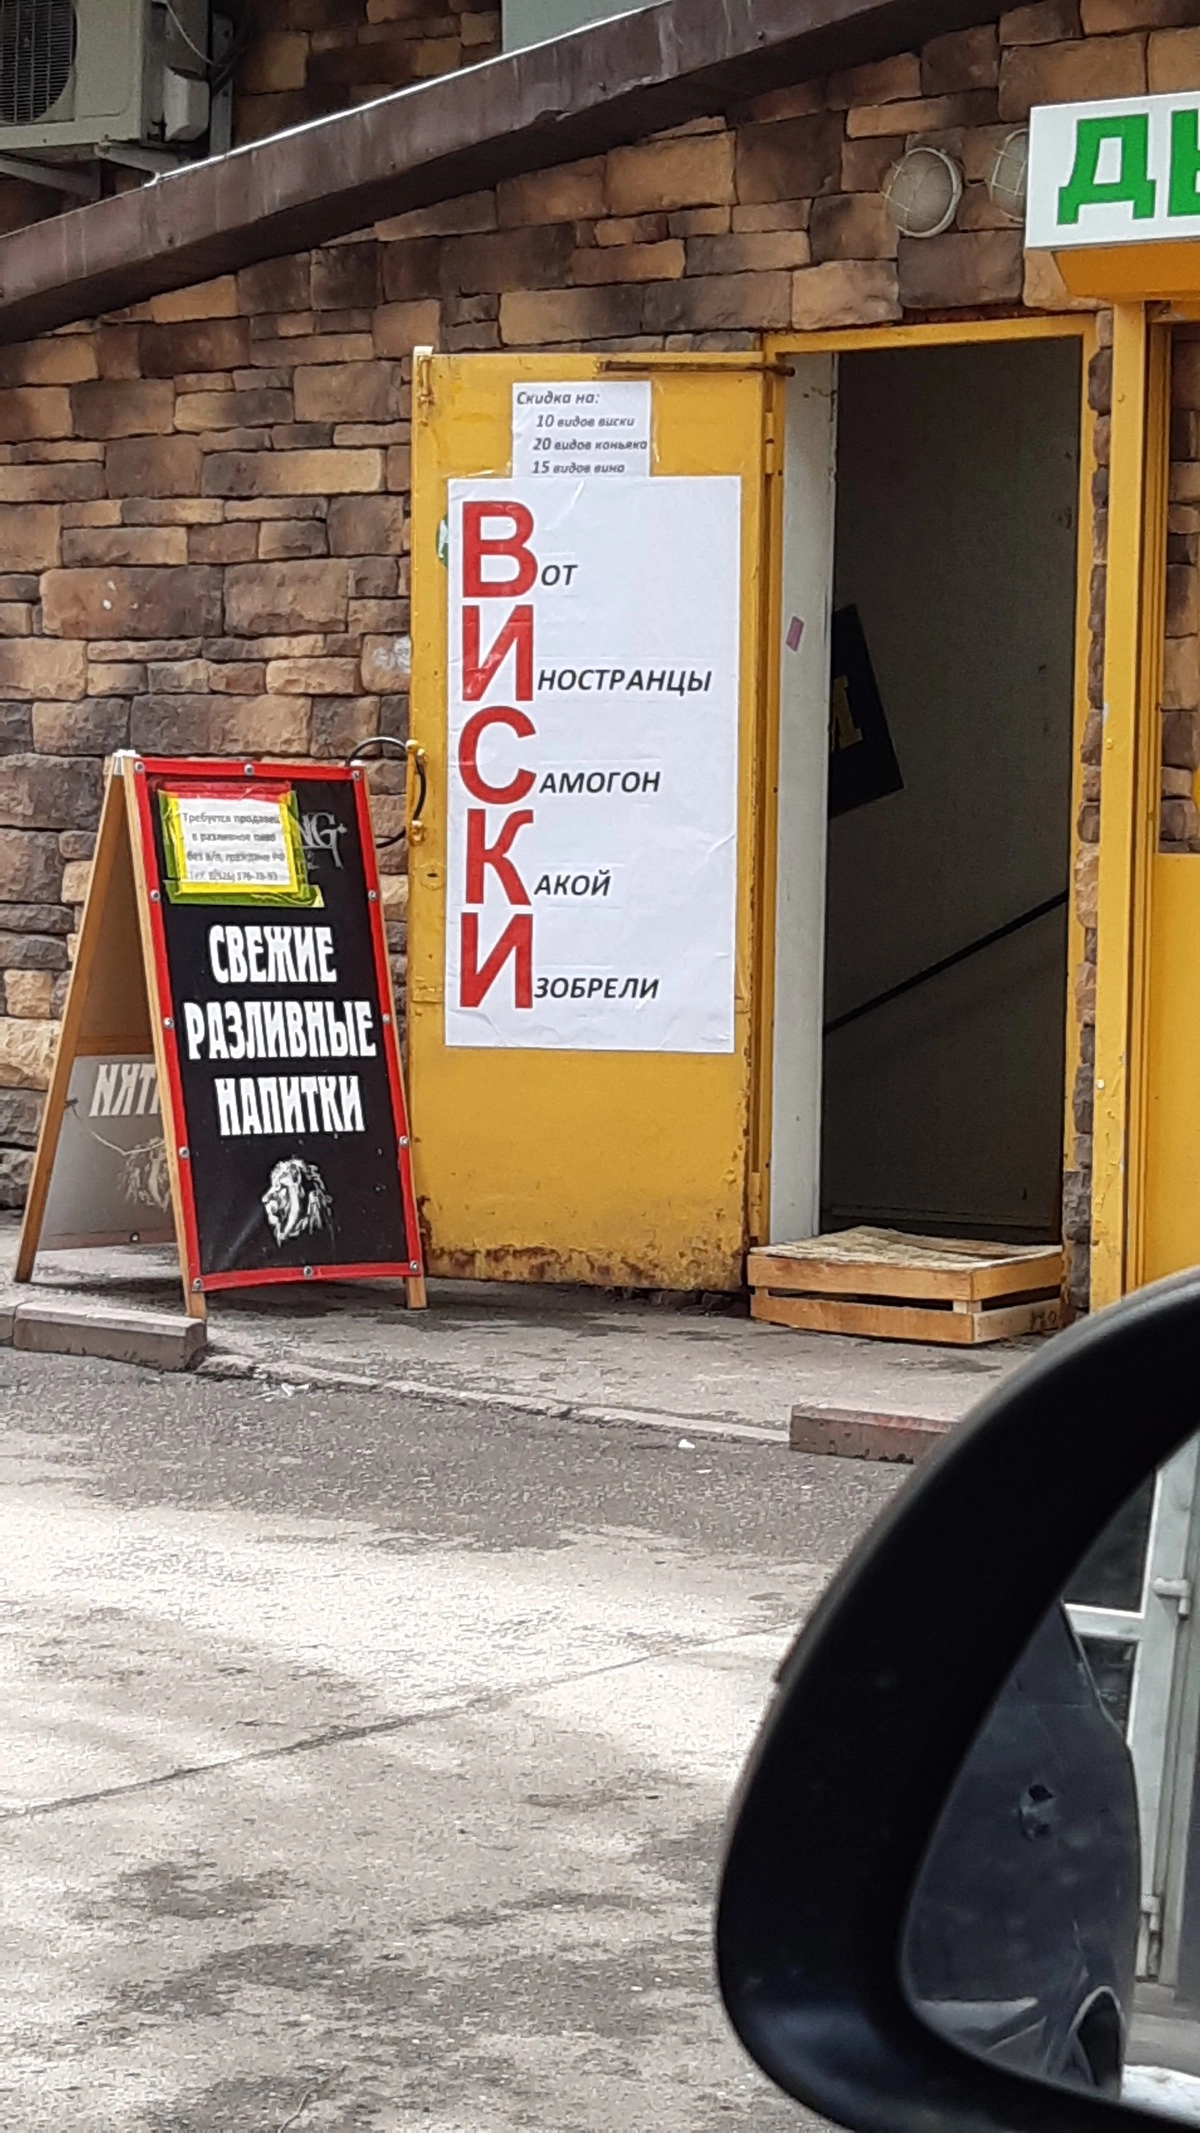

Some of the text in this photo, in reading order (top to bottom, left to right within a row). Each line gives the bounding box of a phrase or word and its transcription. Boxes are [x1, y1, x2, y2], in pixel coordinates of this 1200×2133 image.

[516, 390, 600, 405] Скидка на:
[536, 414, 635, 427] 10 видов виски
[532, 437, 648, 450] 20 видов коньяка
[532, 461, 625, 474] 15 видов вина
[208, 924, 338, 984] СВЕЖИЕ
[183, 1000, 377, 1060] РАЗЛИВНЫЕ
[214, 1075, 366, 1136] НАПИТКИ
